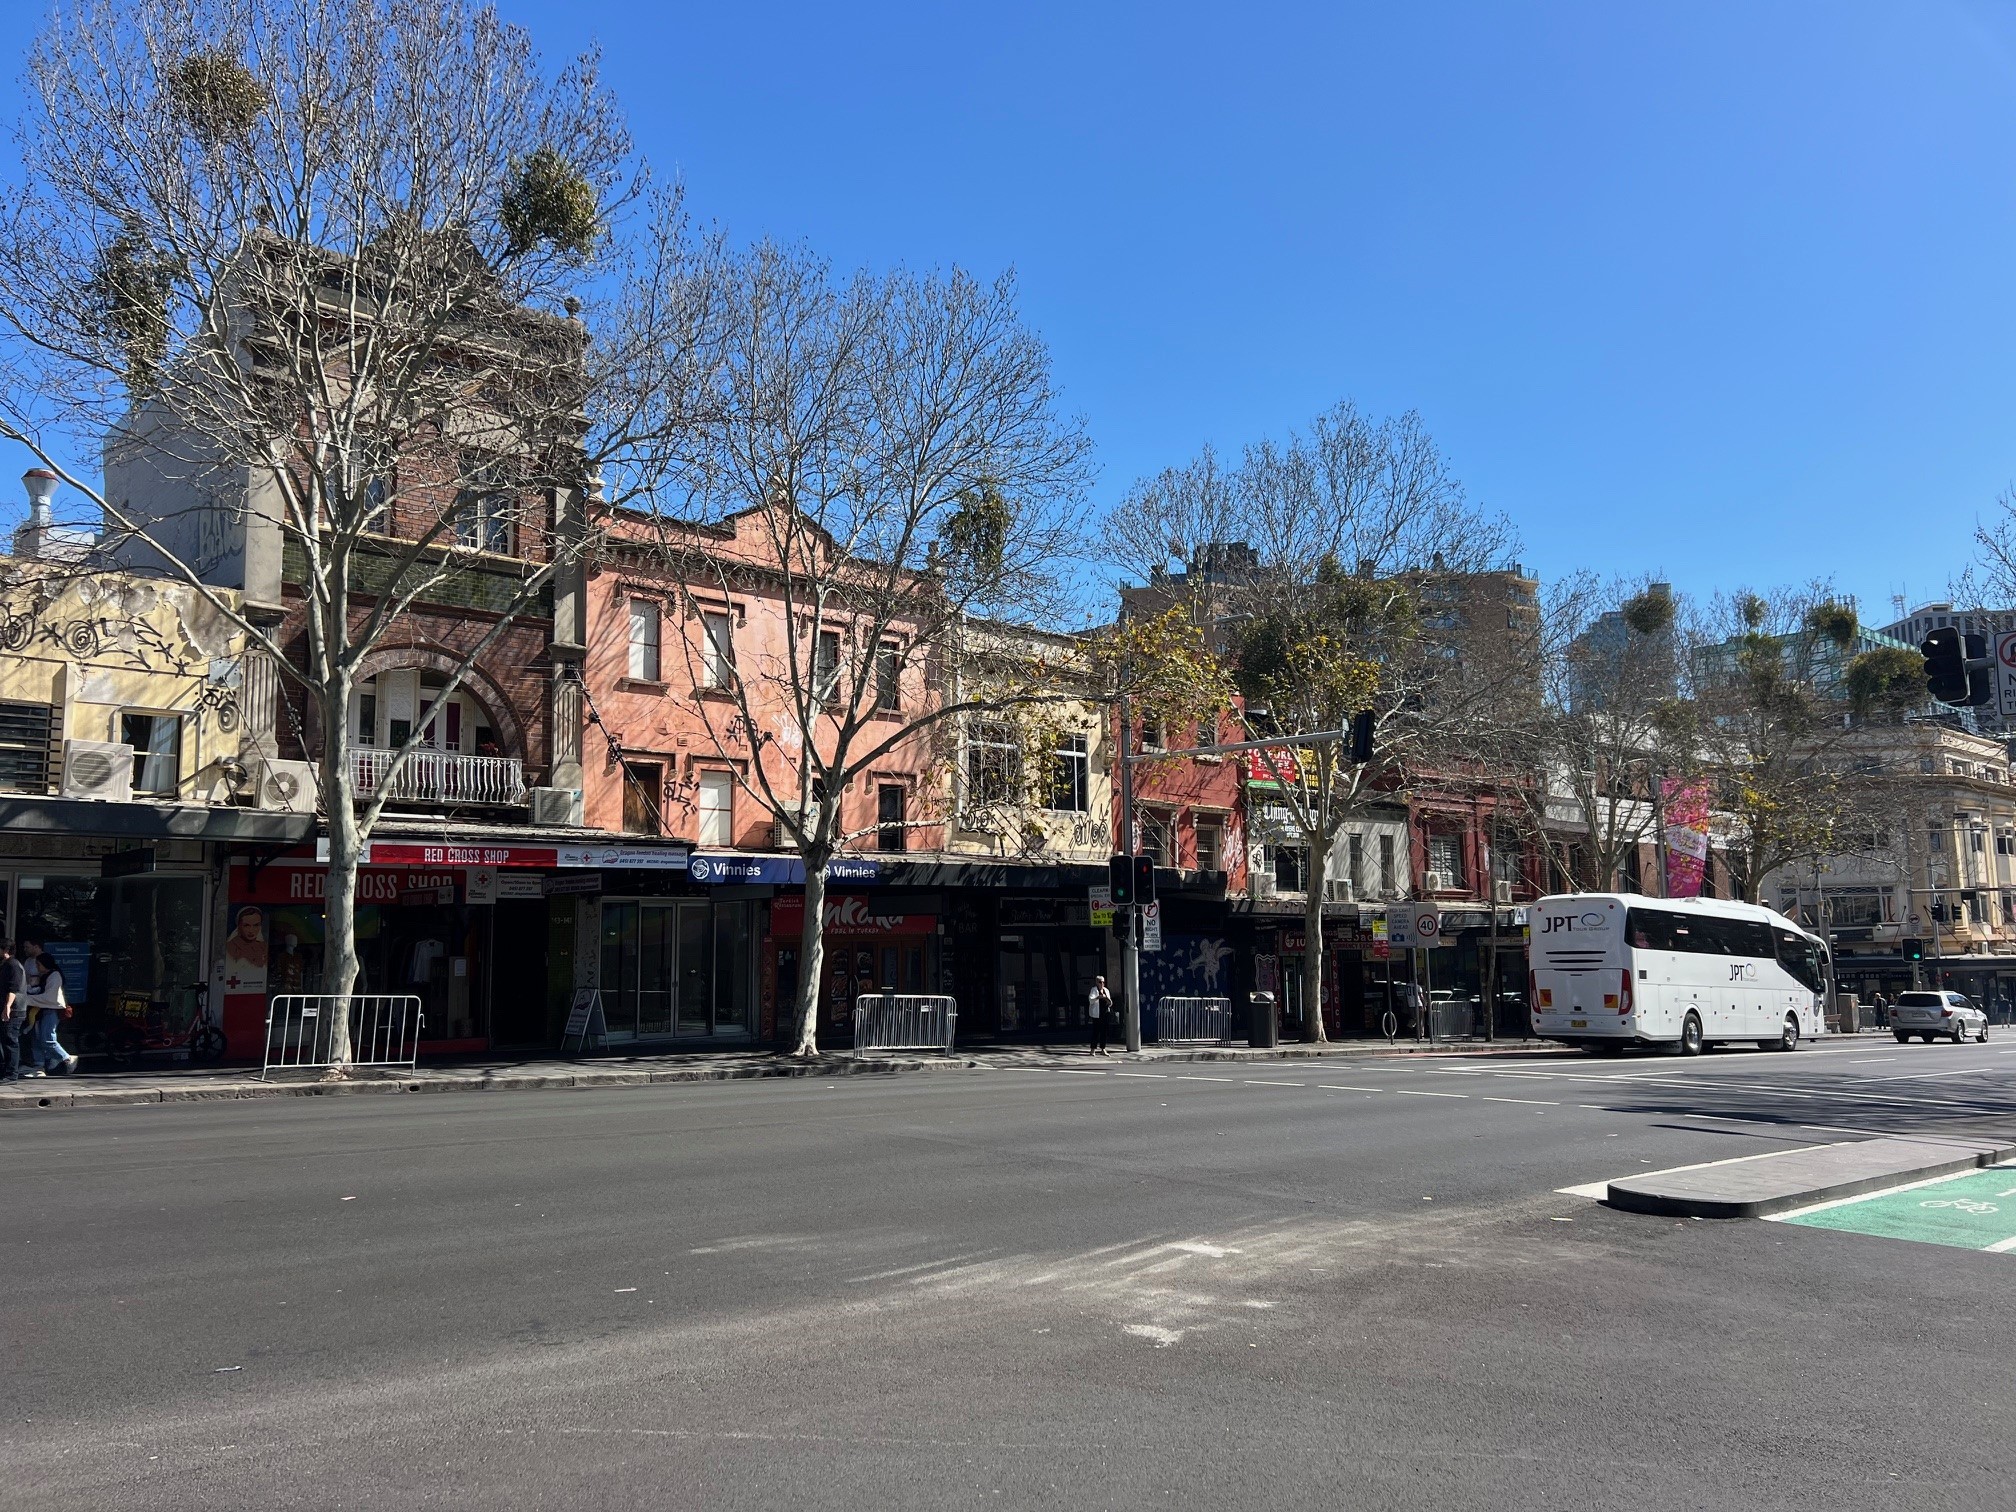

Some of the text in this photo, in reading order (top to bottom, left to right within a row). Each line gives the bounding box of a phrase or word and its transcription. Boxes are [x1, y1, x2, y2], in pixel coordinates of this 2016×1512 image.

[424, 848, 510, 865] RED CROSS SHOP
[713, 862, 761, 876] Vinnies
[834, 865, 876, 879] Vinnies
[290, 873, 326, 899] RED
[356, 874, 398, 900] OSS
[958, 922, 978, 935] BAR
[1420, 920, 1434, 931] 40
[1541, 915, 1579, 934] JPT
[1729, 964, 1745, 981] JPT
